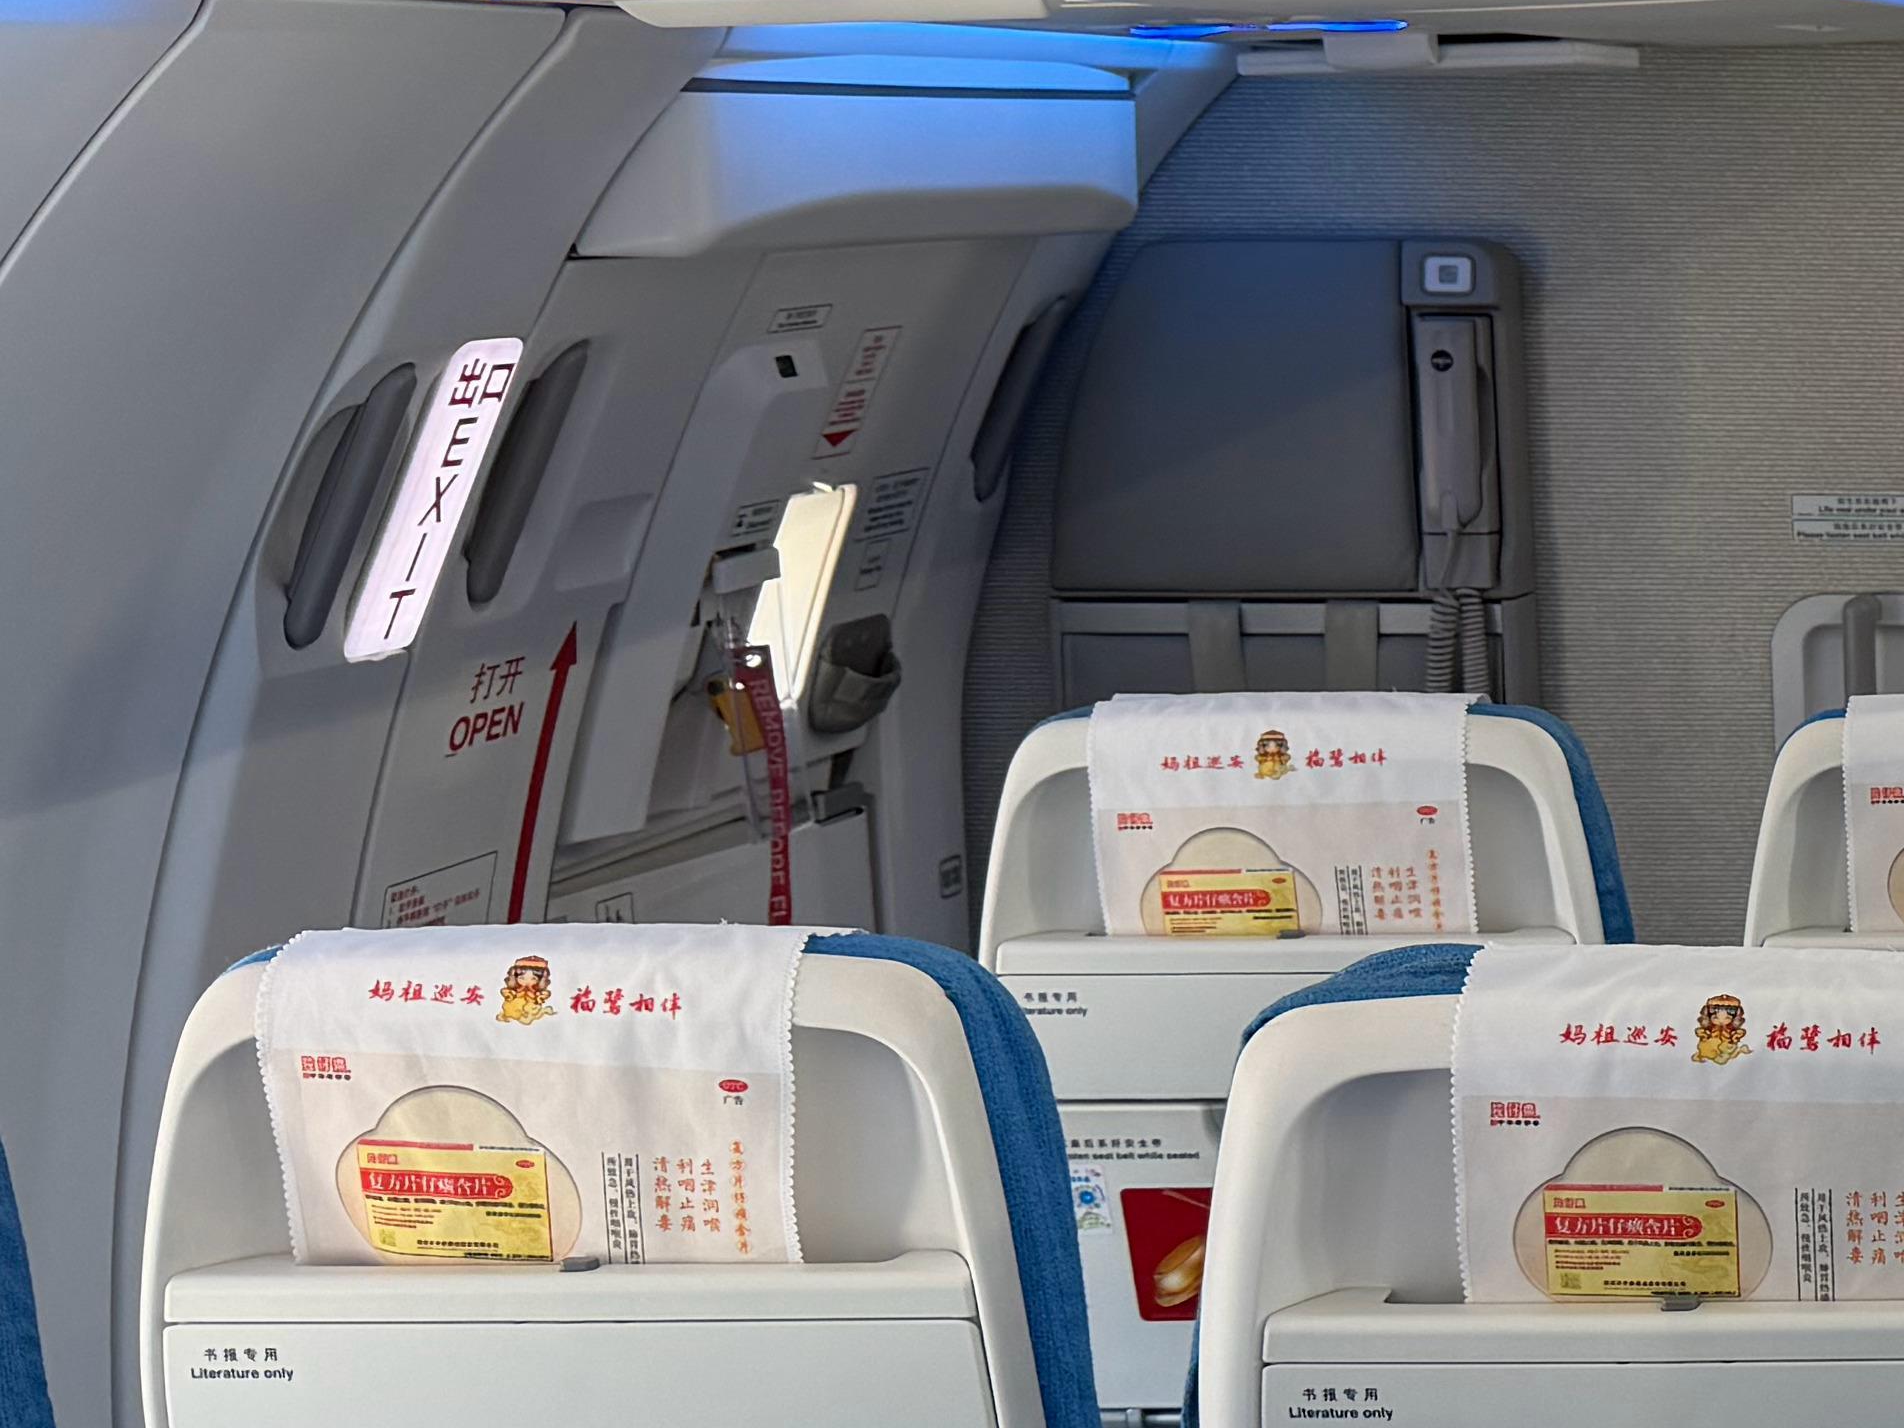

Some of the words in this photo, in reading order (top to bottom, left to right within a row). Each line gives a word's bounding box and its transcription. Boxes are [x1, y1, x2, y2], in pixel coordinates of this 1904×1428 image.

[449, 357, 514, 408] 出口
[385, 416, 476, 639] EXIT
[470, 656, 526, 704] 打开
[450, 702, 525, 752] OPEN
[750, 678, 785, 778] REMOVE
[368, 979, 485, 1007] 妈祖巡安
[569, 985, 684, 1020] 福鹭相伴
[1560, 1024, 1679, 1049] 妈祖巡安
[1765, 1022, 1883, 1056] 福鹭相伴
[1553, 1214, 1681, 1236] 复方片仔癀含片
[1845, 1190, 1865, 1267] 清热解毒
[1869, 1190, 1890, 1267] 利咽止痛
[203, 1347, 279, 1364] 书报专用
[190, 1366, 258, 1380] Literature
[263, 1367, 294, 1382] only
[1302, 1387, 1380, 1403] 书报专用
[1289, 1406, 1359, 1420] Literature
[1362, 1406, 1394, 1422] only
